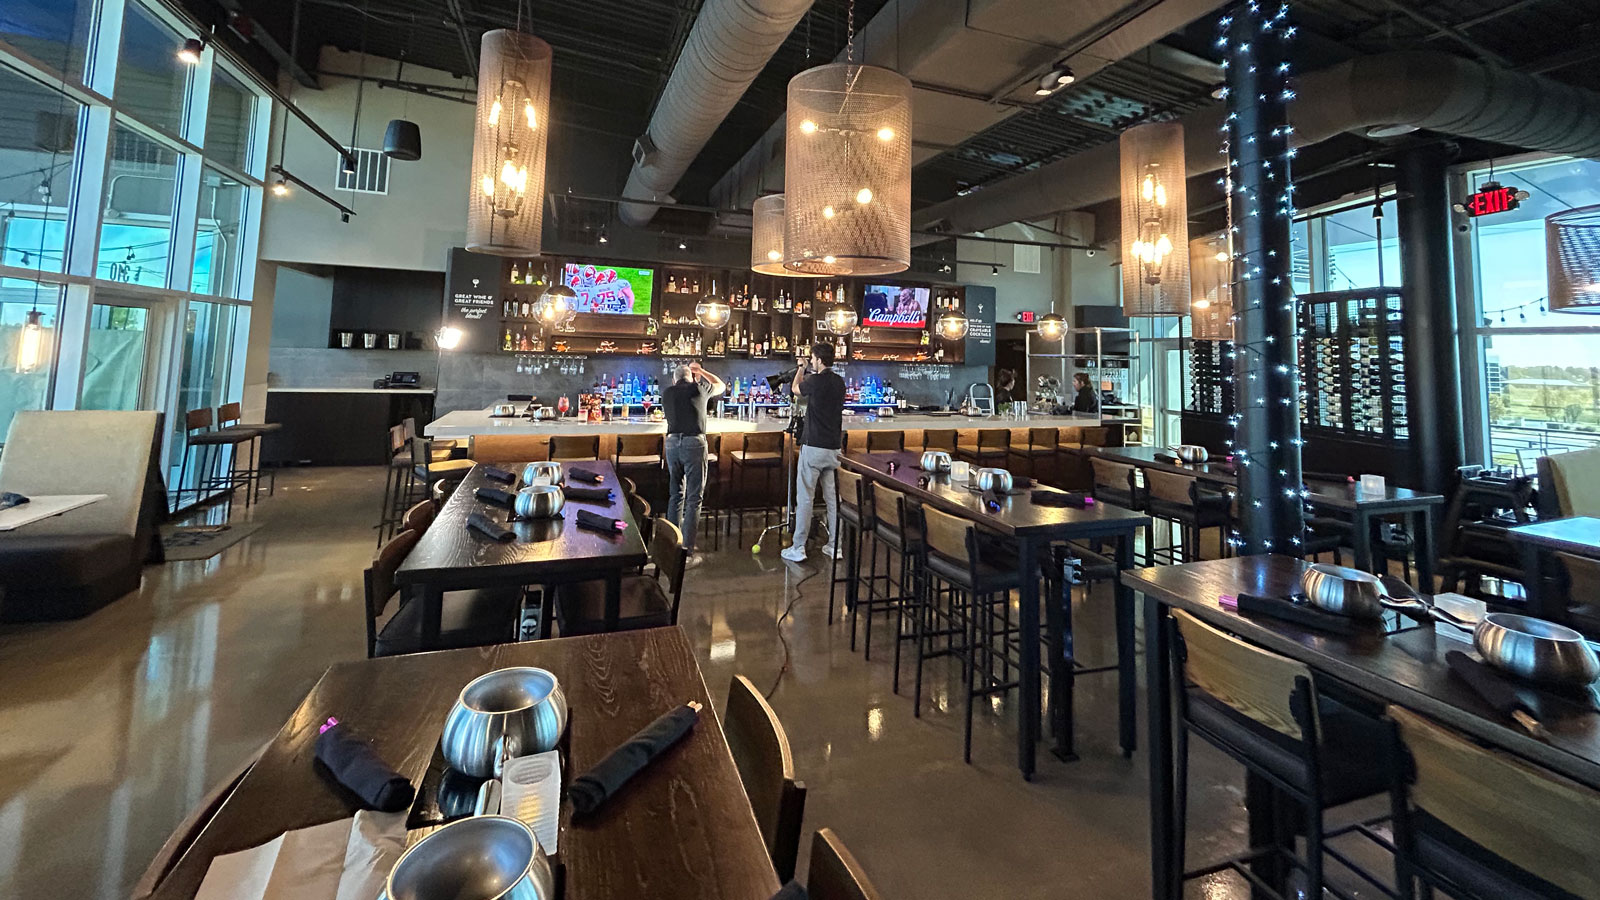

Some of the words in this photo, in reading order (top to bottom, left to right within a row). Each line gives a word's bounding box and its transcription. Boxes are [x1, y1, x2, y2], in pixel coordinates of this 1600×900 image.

[1474, 188, 1509, 216] EXIT
[597, 291, 616, 305] 75
[869, 308, 921, 327] Campbell's
